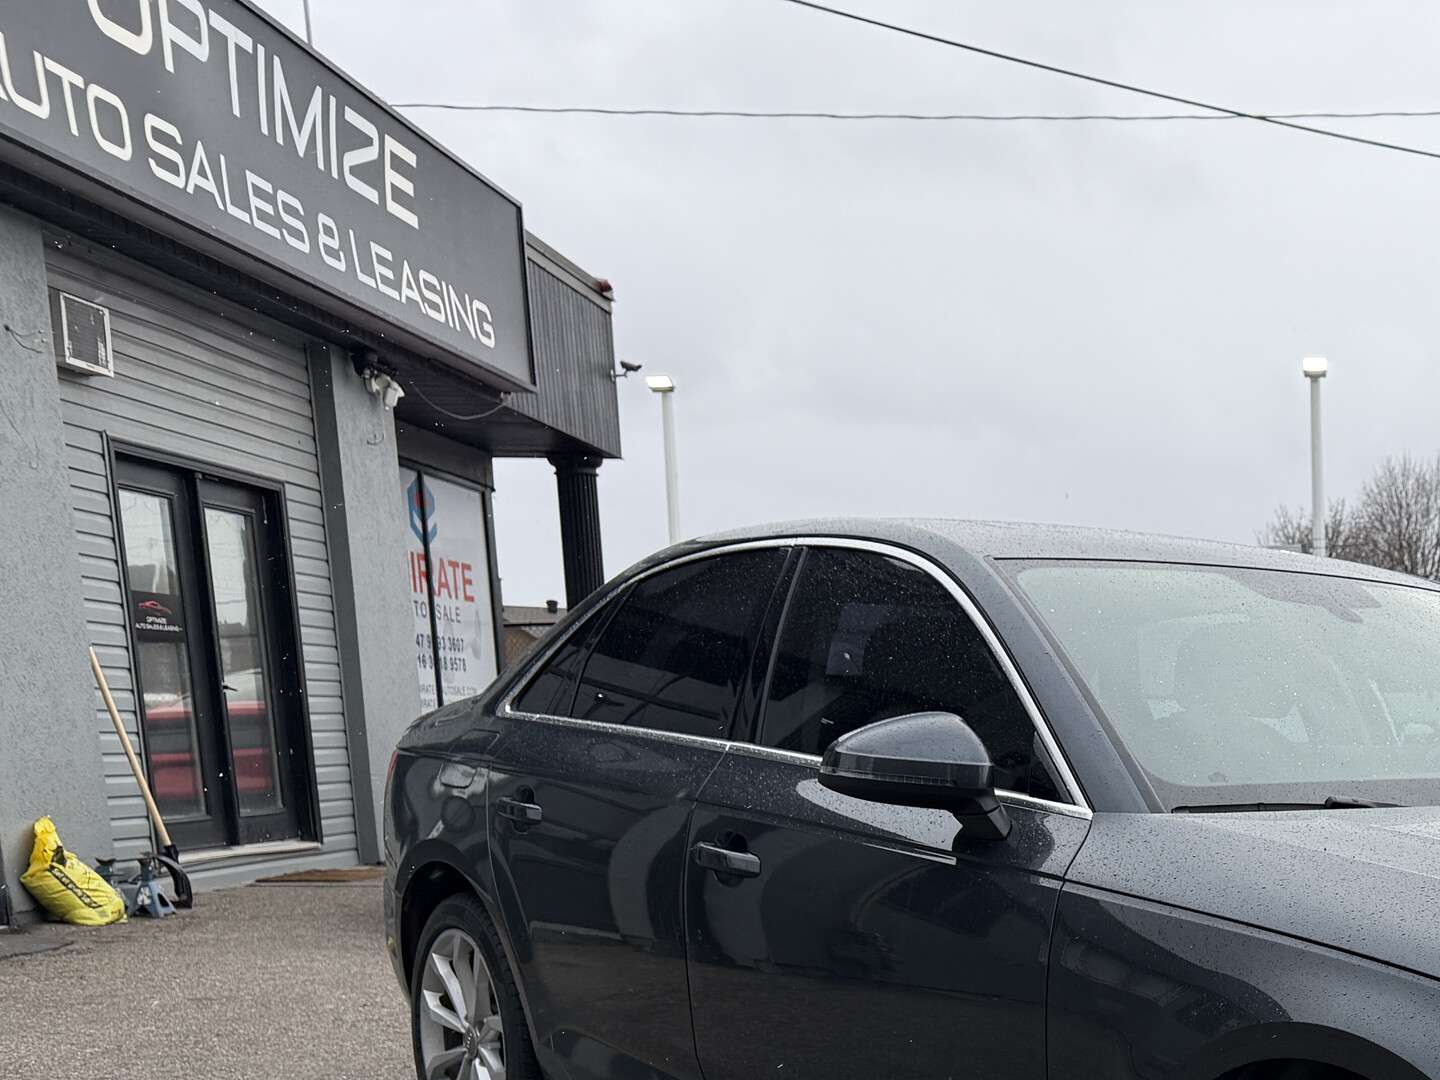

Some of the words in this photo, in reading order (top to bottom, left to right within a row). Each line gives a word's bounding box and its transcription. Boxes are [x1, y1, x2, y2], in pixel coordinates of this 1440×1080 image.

[0, 32, 132, 161] UTO
[144, 113, 309, 252] SALES
[318, 213, 346, 272] &
[348, 229, 495, 349] LEASING
[436, 604, 461, 624] SALE
